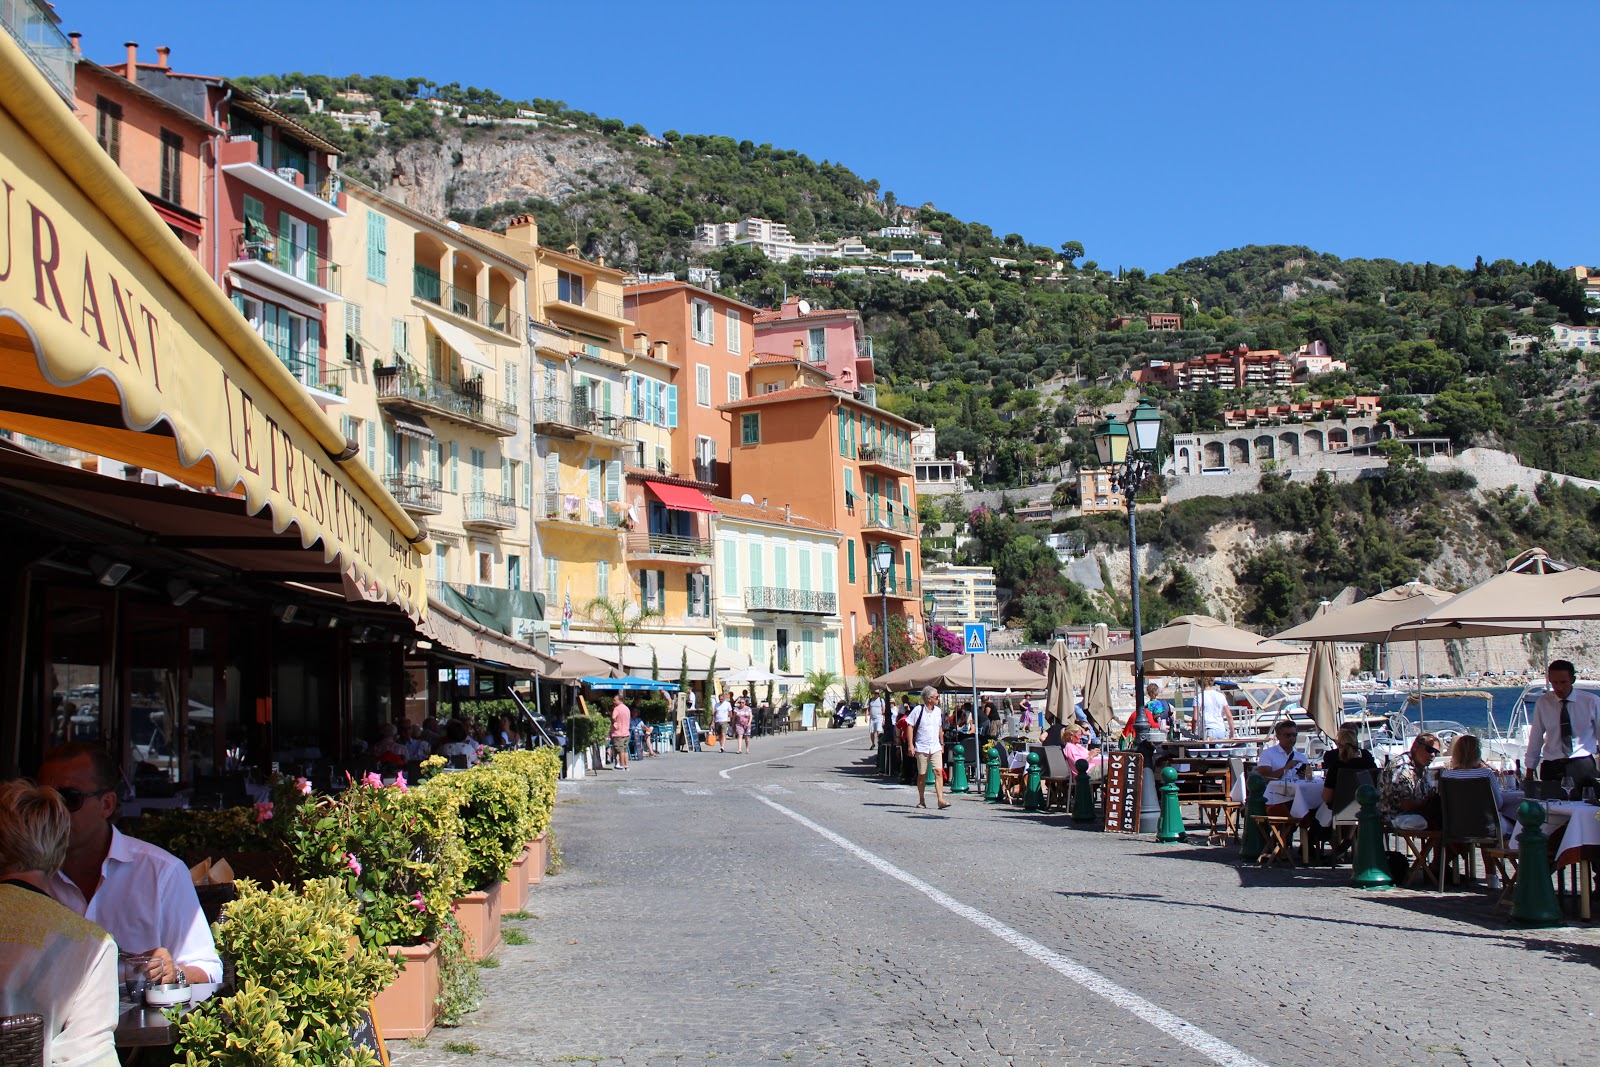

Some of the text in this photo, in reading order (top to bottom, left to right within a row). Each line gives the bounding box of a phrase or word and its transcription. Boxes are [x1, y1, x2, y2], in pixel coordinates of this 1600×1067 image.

[222, 369, 260, 476] LE
[265, 413, 373, 569] TRASTEVERE
[1168, 661, 1181, 669] LA
[1210, 661, 1261, 669] GERMAINE
[1107, 754, 1122, 827] VOITURIER
[1123, 755, 1136, 829] VALET PARKING
